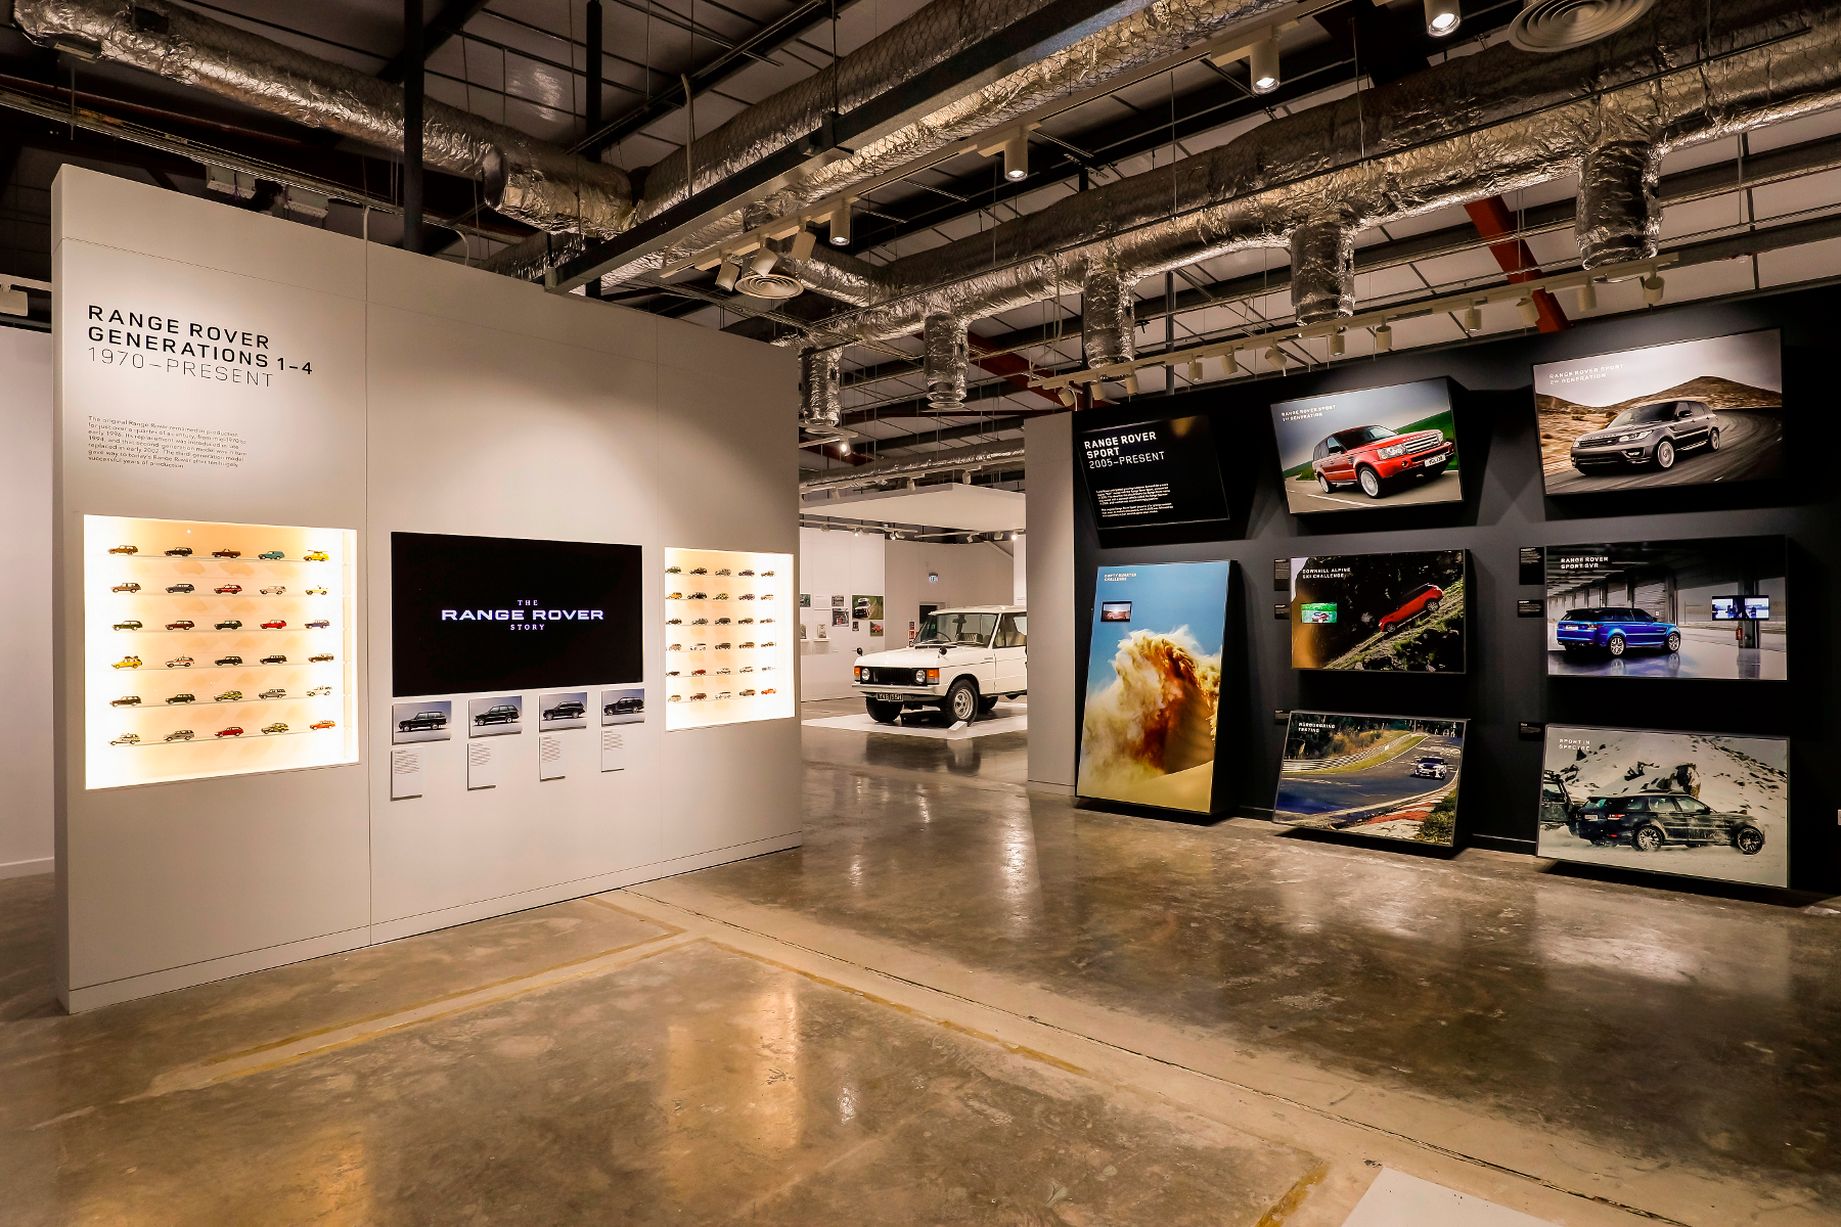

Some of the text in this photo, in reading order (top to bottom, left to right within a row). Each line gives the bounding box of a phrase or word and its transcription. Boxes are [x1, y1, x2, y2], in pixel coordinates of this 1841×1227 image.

[88, 304, 270, 350] RANGE ROVER
[88, 325, 269, 368] GENERATIONS
[1084, 431, 1157, 450] RANGE ROVER
[1086, 447, 1120, 460] SPORT
[441, 609, 604, 621] RANGE ROVER
[510, 623, 545, 631] STORY
